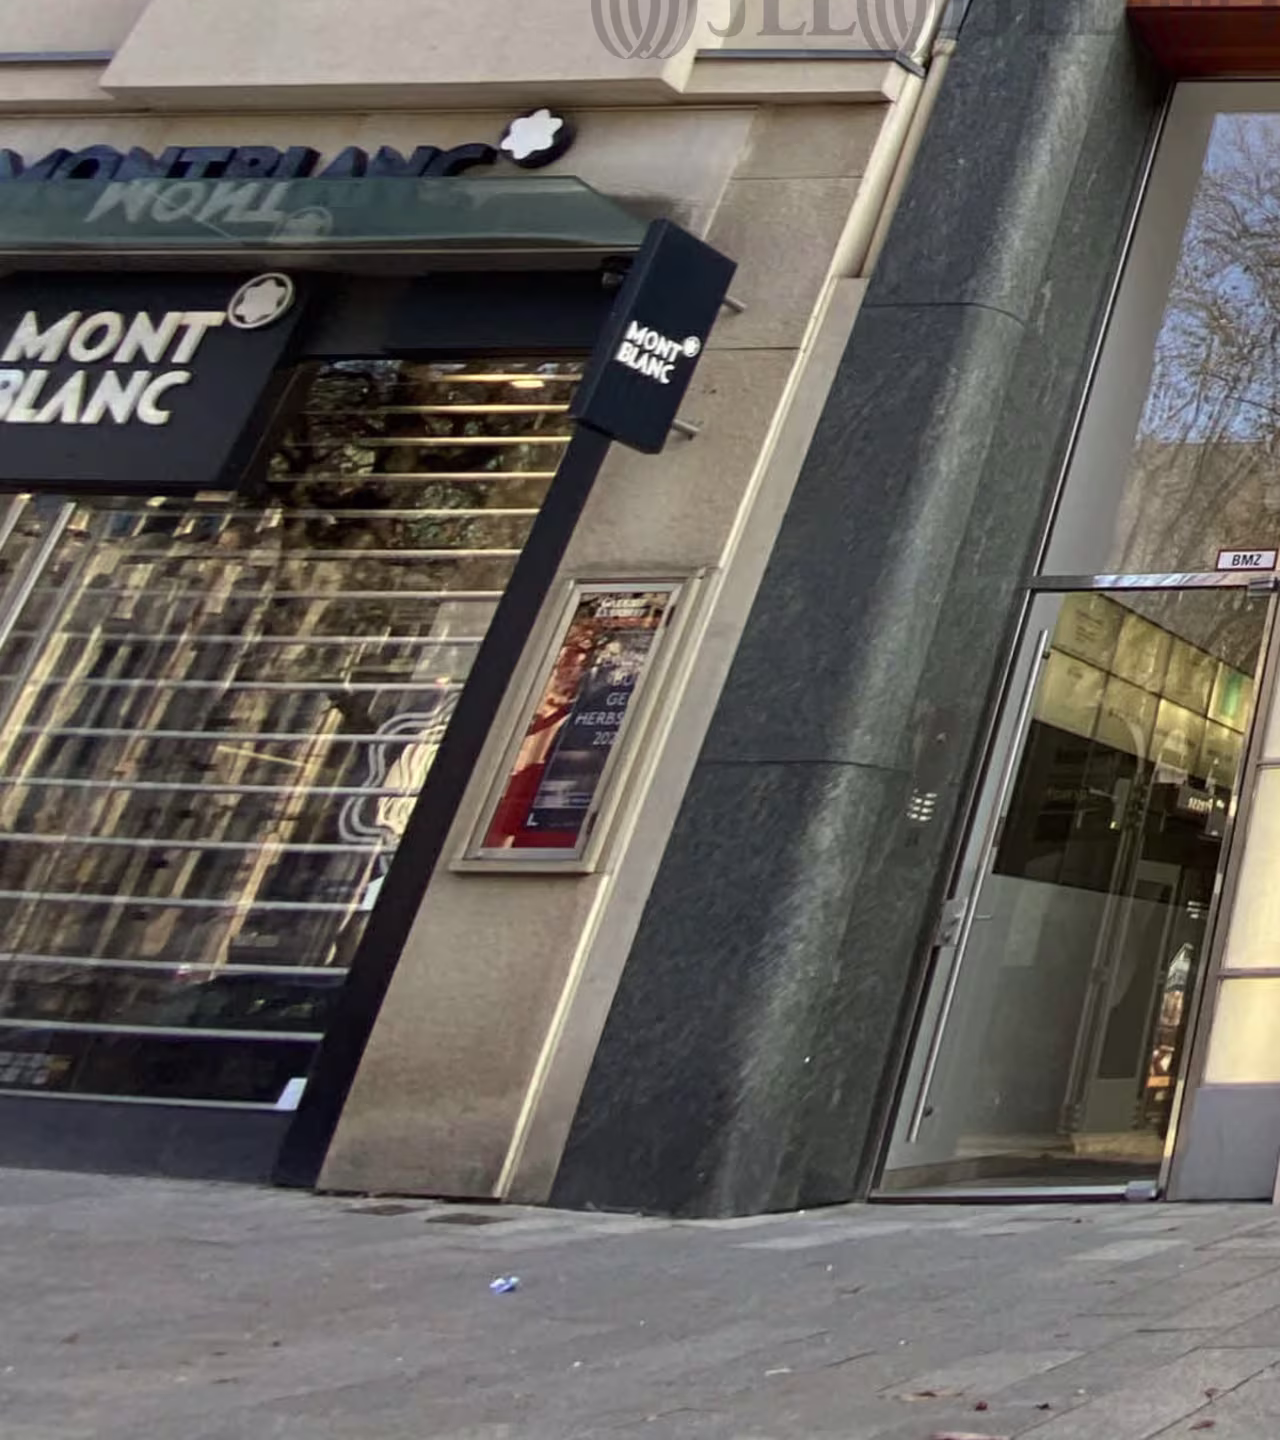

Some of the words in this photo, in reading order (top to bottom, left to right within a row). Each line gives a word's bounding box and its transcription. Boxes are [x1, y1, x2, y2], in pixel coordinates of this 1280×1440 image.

[0, 310, 227, 363] MONT
[625, 320, 683, 363] MONT
[615, 340, 675, 384] BLANC
[1231, 553, 1262, 567] BMZ
